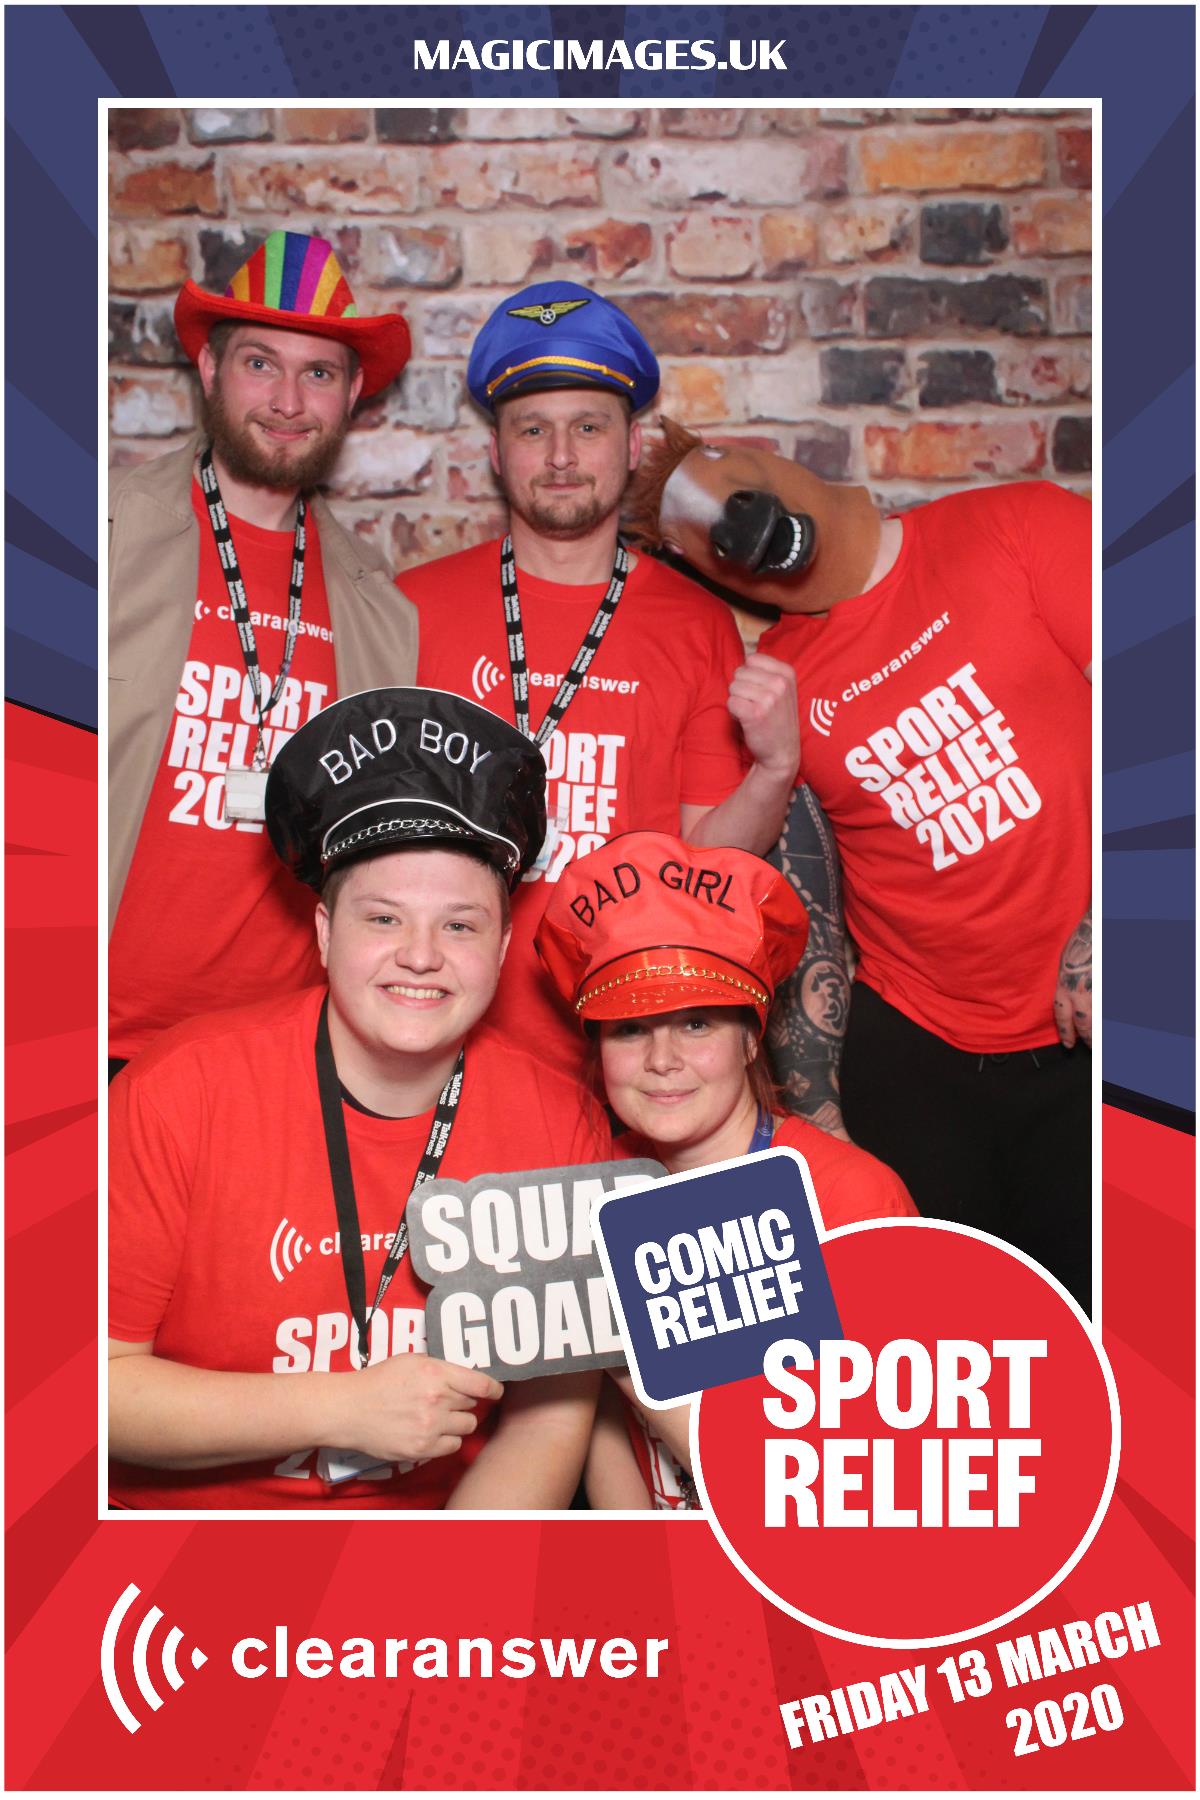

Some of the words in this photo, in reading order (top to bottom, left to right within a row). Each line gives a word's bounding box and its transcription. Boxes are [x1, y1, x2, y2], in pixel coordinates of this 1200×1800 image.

[216, 605, 334, 643] claraswe
[841, 611, 951, 702] clearanswer
[175, 661, 328, 729] SPORT
[526, 668, 640, 694] learnswer
[168, 715, 297, 775] RELI
[318, 718, 397, 785] BAD
[419, 718, 493, 774] BOY
[529, 729, 626, 786] ORT
[844, 662, 995, 792] SPORT
[168, 771, 264, 833] 20
[880, 710, 1019, 829] RELIEF
[545, 781, 618, 834] IEF
[915, 767, 1042, 872] 2020
[569, 862, 641, 928] BAD
[659, 861, 736, 913] GIRL
[447, 1072, 463, 1107] TalkTalk
[425, 1120, 442, 1156] Business
[432, 1122, 452, 1158] TalkTalk
[421, 1174, 657, 1274] SQUA
[272, 1307, 428, 1374] SPOR
[440, 1277, 625, 1370] GOAL
